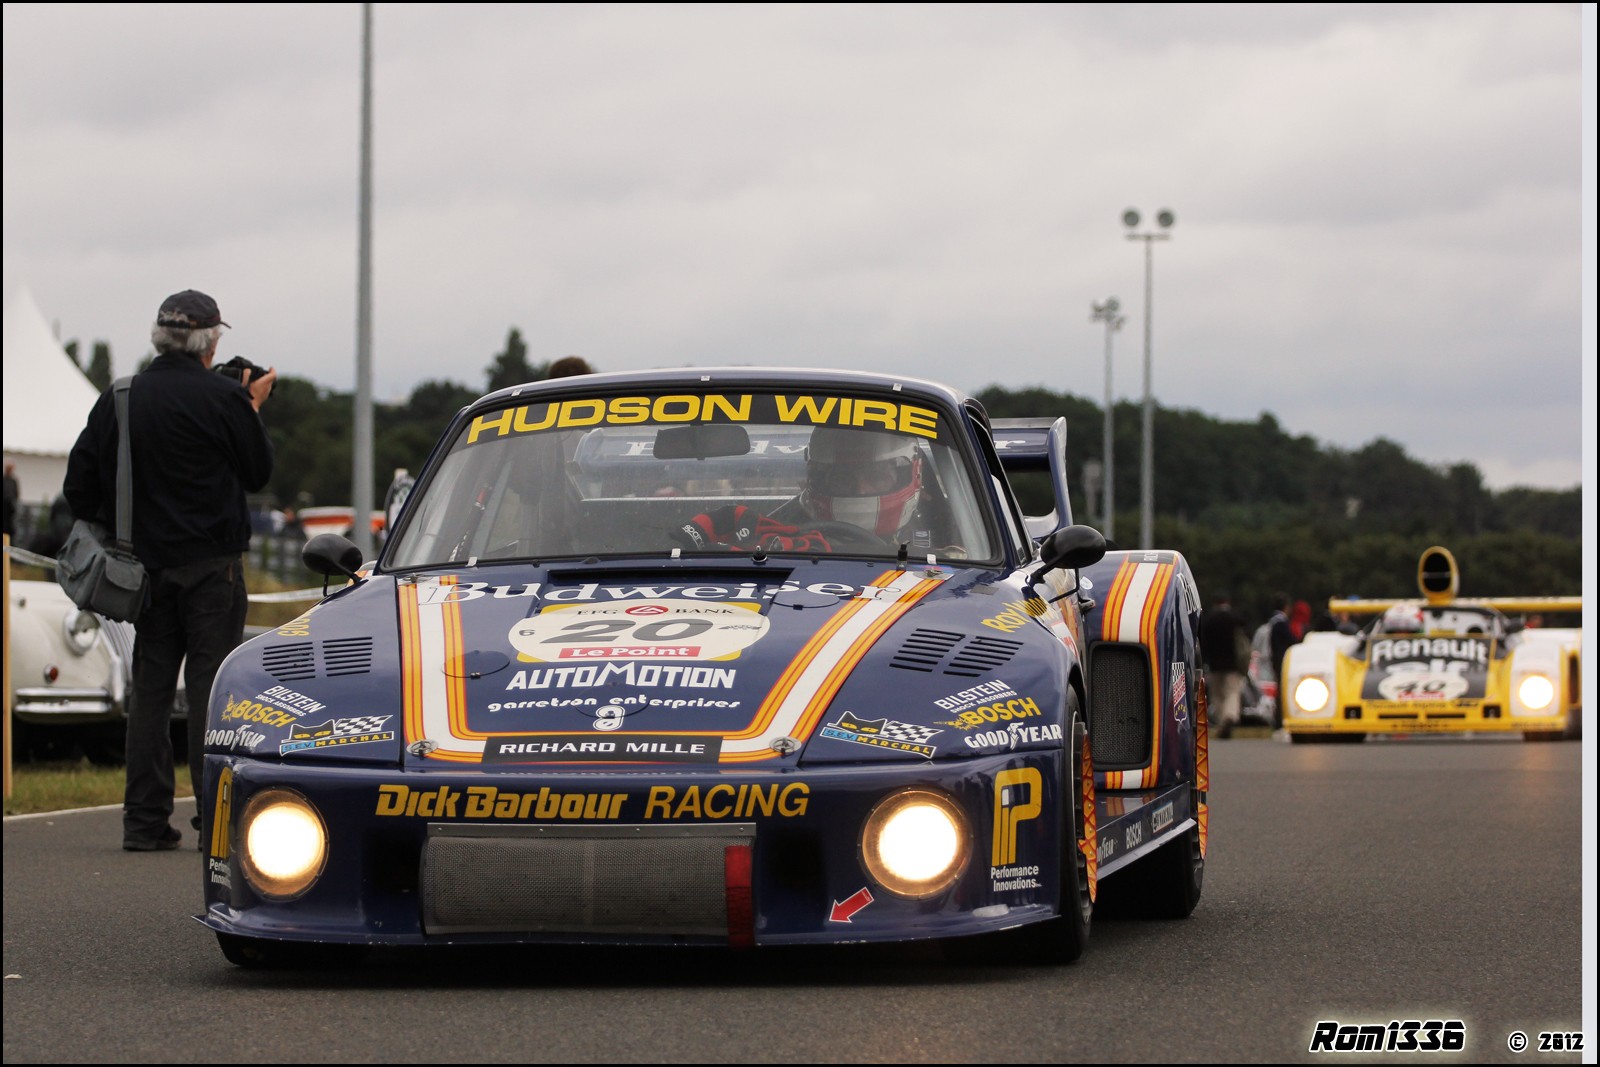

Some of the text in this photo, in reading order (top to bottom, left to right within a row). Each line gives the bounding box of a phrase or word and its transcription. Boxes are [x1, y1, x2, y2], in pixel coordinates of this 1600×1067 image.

[467, 395, 940, 444] HUDSON WIRE
[418, 580, 902, 605] Budweiser
[518, 629, 536, 637] 6
[539, 619, 714, 644] 20
[569, 646, 690, 658] Le Point
[1371, 638, 1488, 664] Renault
[505, 661, 737, 691] AUTOMOTION
[263, 685, 326, 713] BILSTEIN
[487, 694, 741, 713] garretson enterprises
[934, 679, 1011, 709] BILSTEIN
[950, 690, 1018, 713] SHOCK ABSORBERS
[231, 700, 297, 727] BOSCH
[959, 697, 1042, 725] BOSCH
[315, 733, 391, 747] MARCHAL
[499, 742, 706, 754] RICHARD MILLE
[857, 736, 931, 755] MARCHAL
[375, 782, 811, 820] Dick Barbour RACING
[1126, 821, 1142, 850] BOSCH
[990, 865, 1040, 879] Performance
[993, 877, 1037, 892] Innovations
